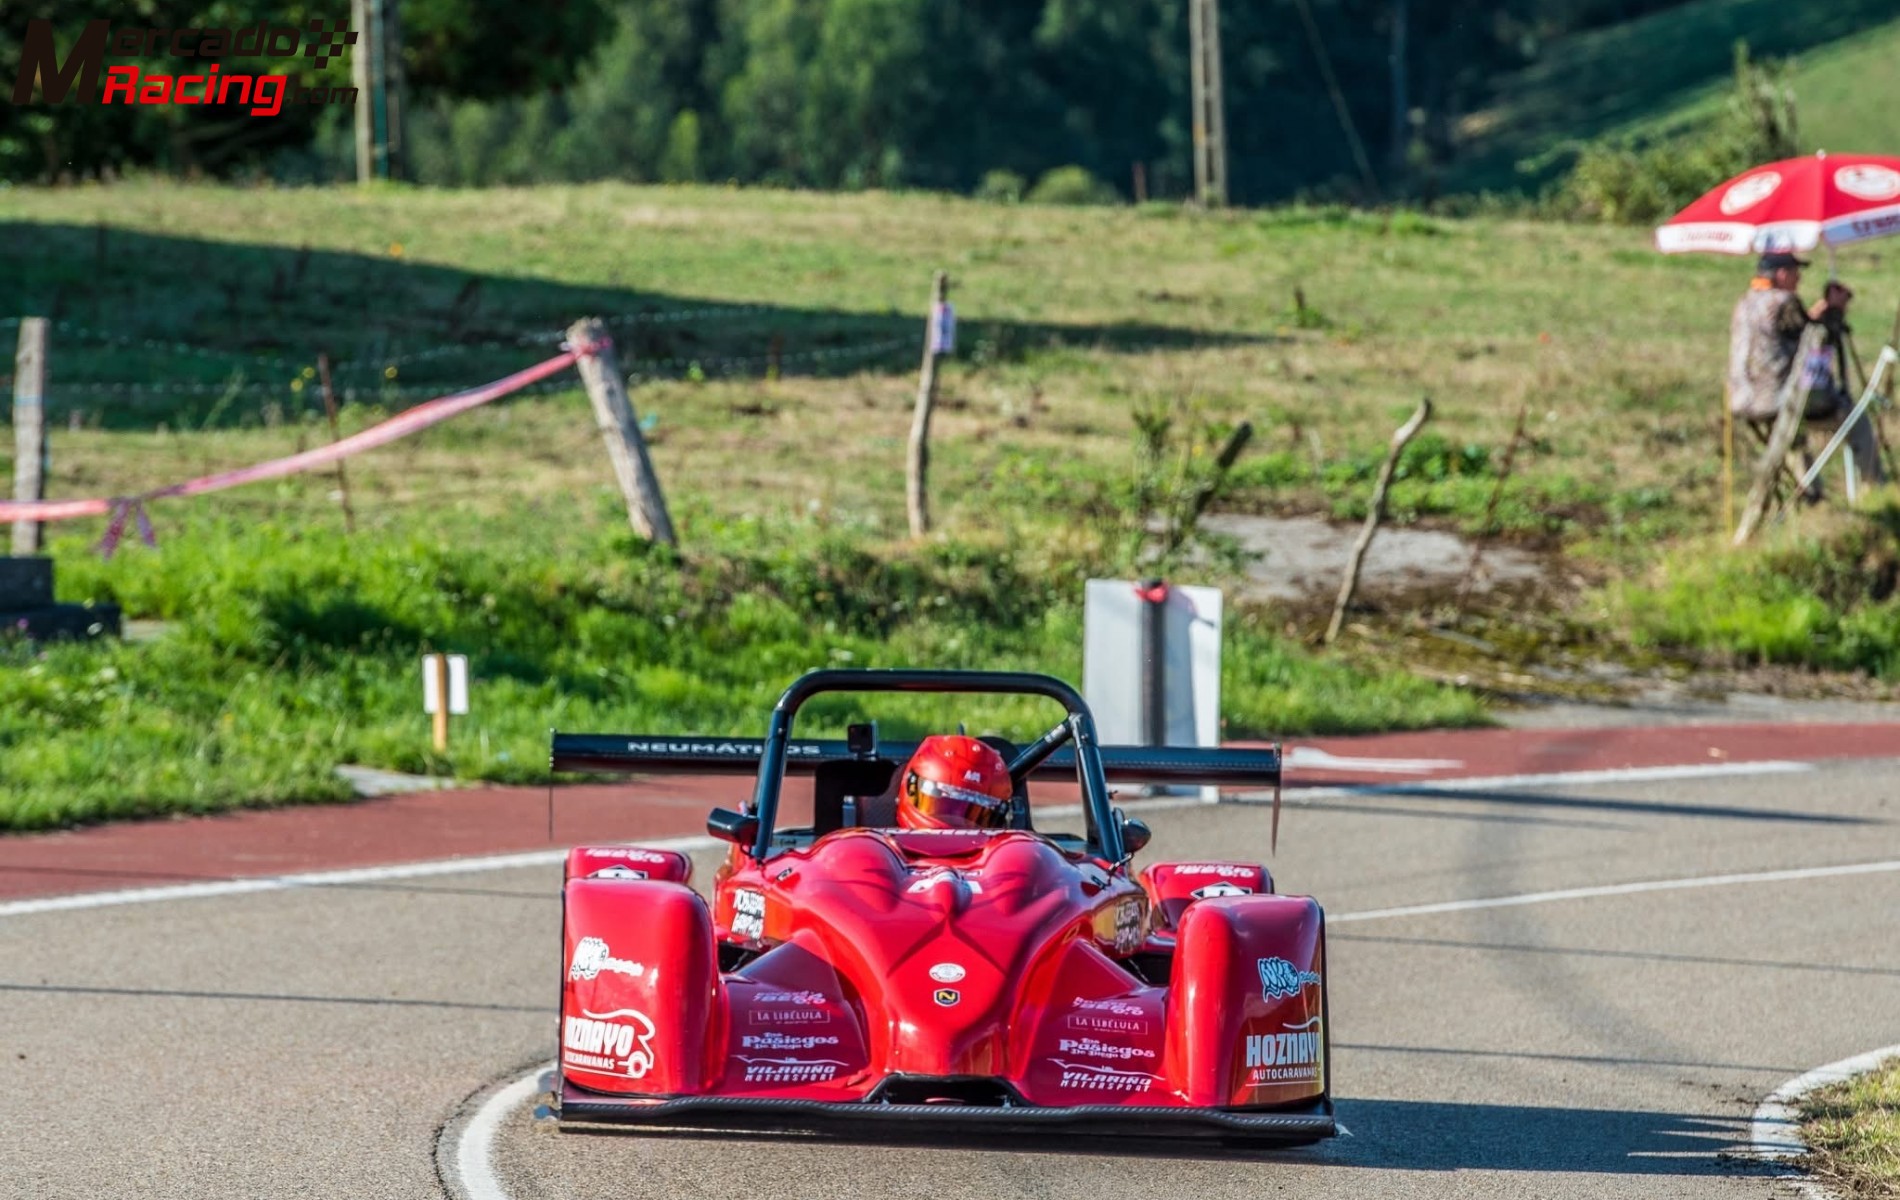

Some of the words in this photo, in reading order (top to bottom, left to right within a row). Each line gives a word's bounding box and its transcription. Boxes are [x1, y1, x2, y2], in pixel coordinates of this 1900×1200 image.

[757, 1011, 770, 1021] LA
[1075, 1016, 1088, 1026] LA
[742, 1035, 839, 1049] Pasiegos
[1059, 1039, 1156, 1059] Pasiegos
